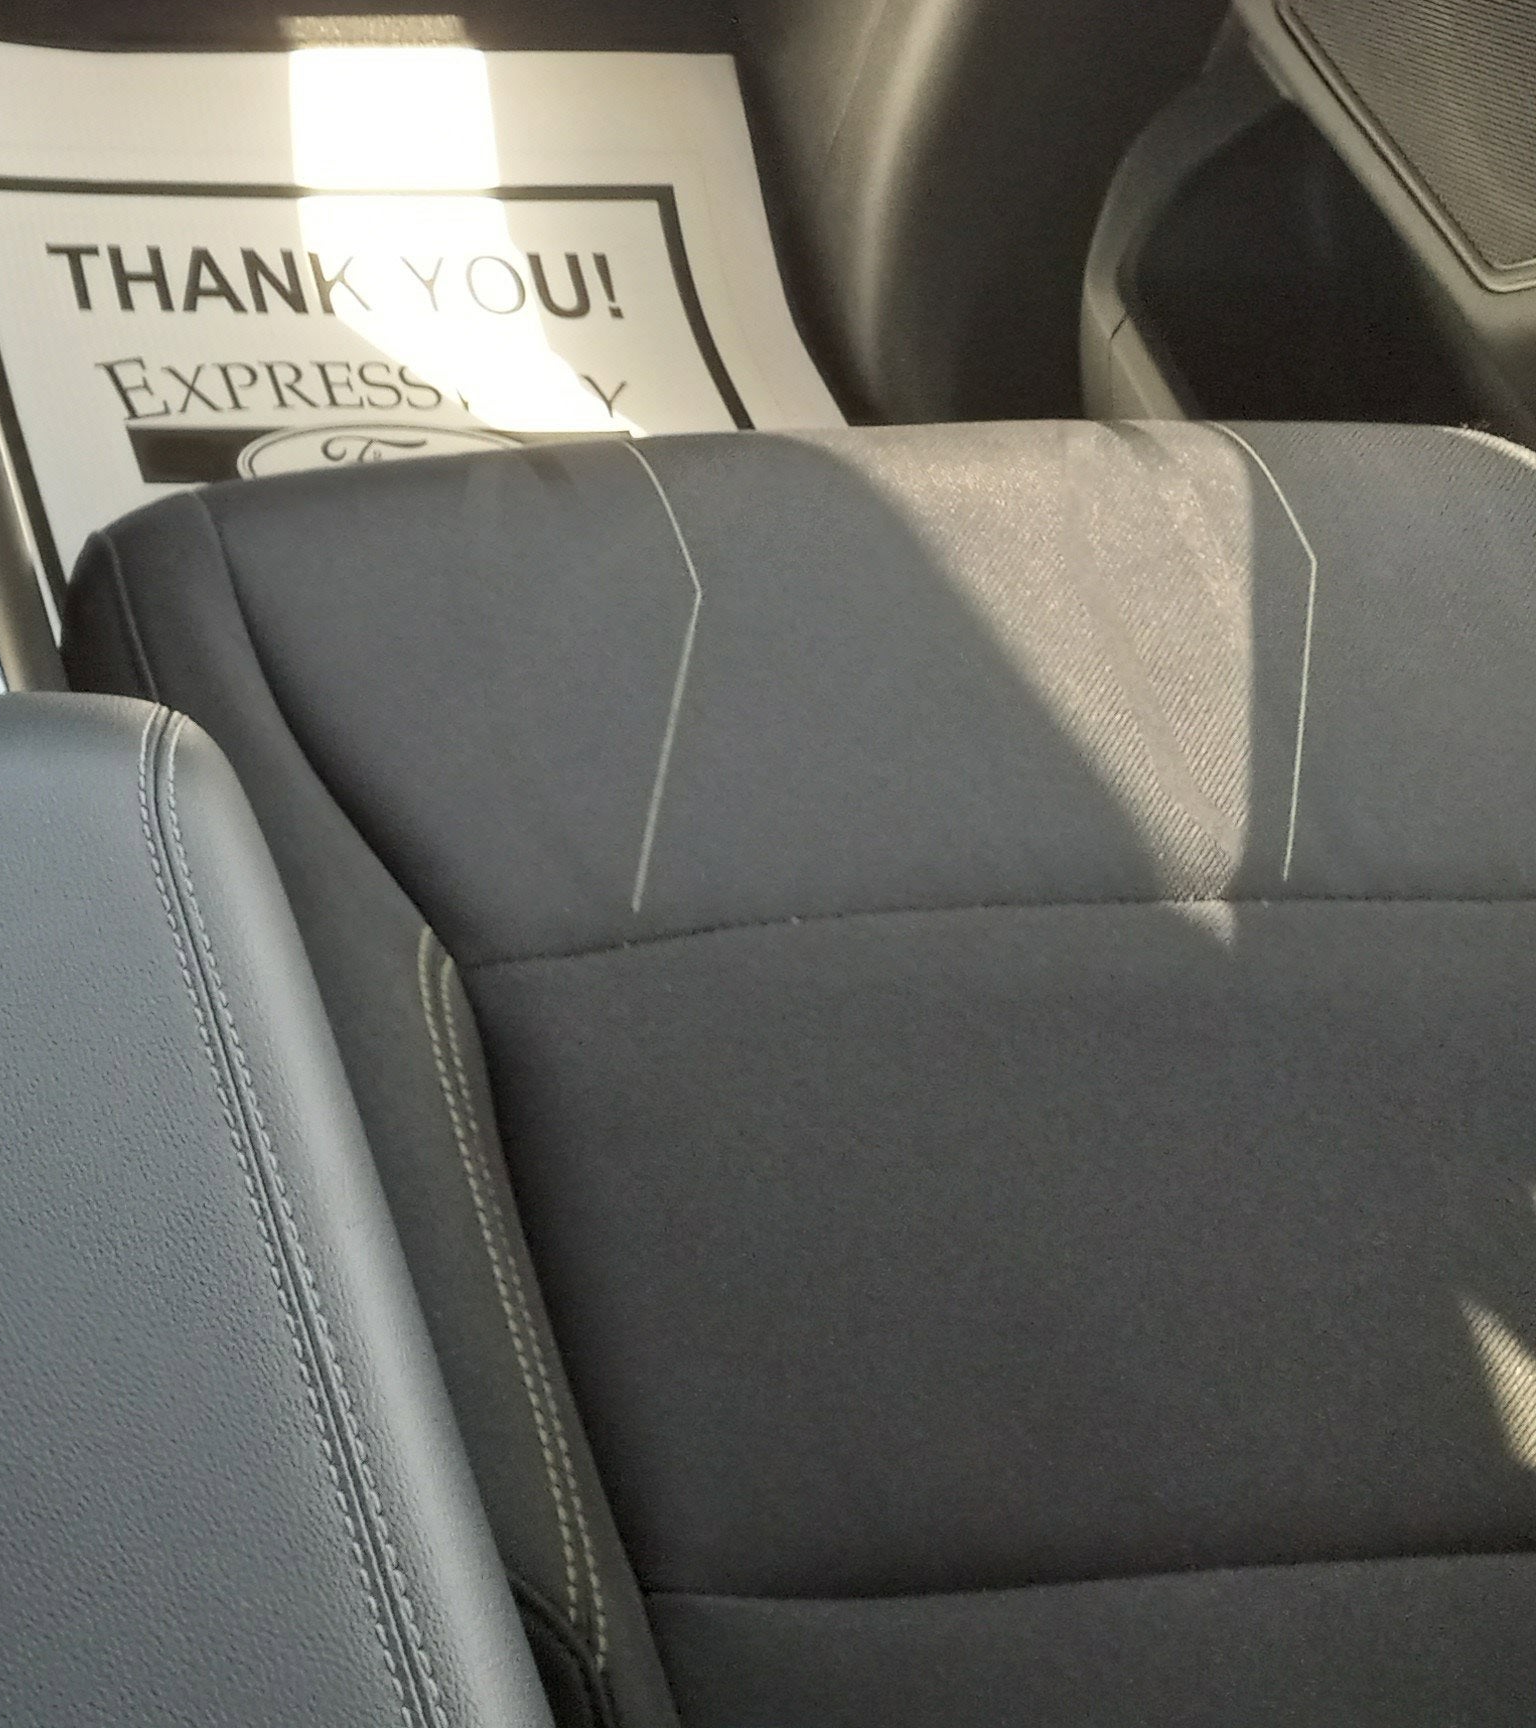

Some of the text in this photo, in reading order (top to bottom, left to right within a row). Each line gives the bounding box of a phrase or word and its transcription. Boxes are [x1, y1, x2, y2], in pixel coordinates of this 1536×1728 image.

[44, 242, 625, 320] THANK YOU!
[95, 356, 629, 422] EXPRESSY
